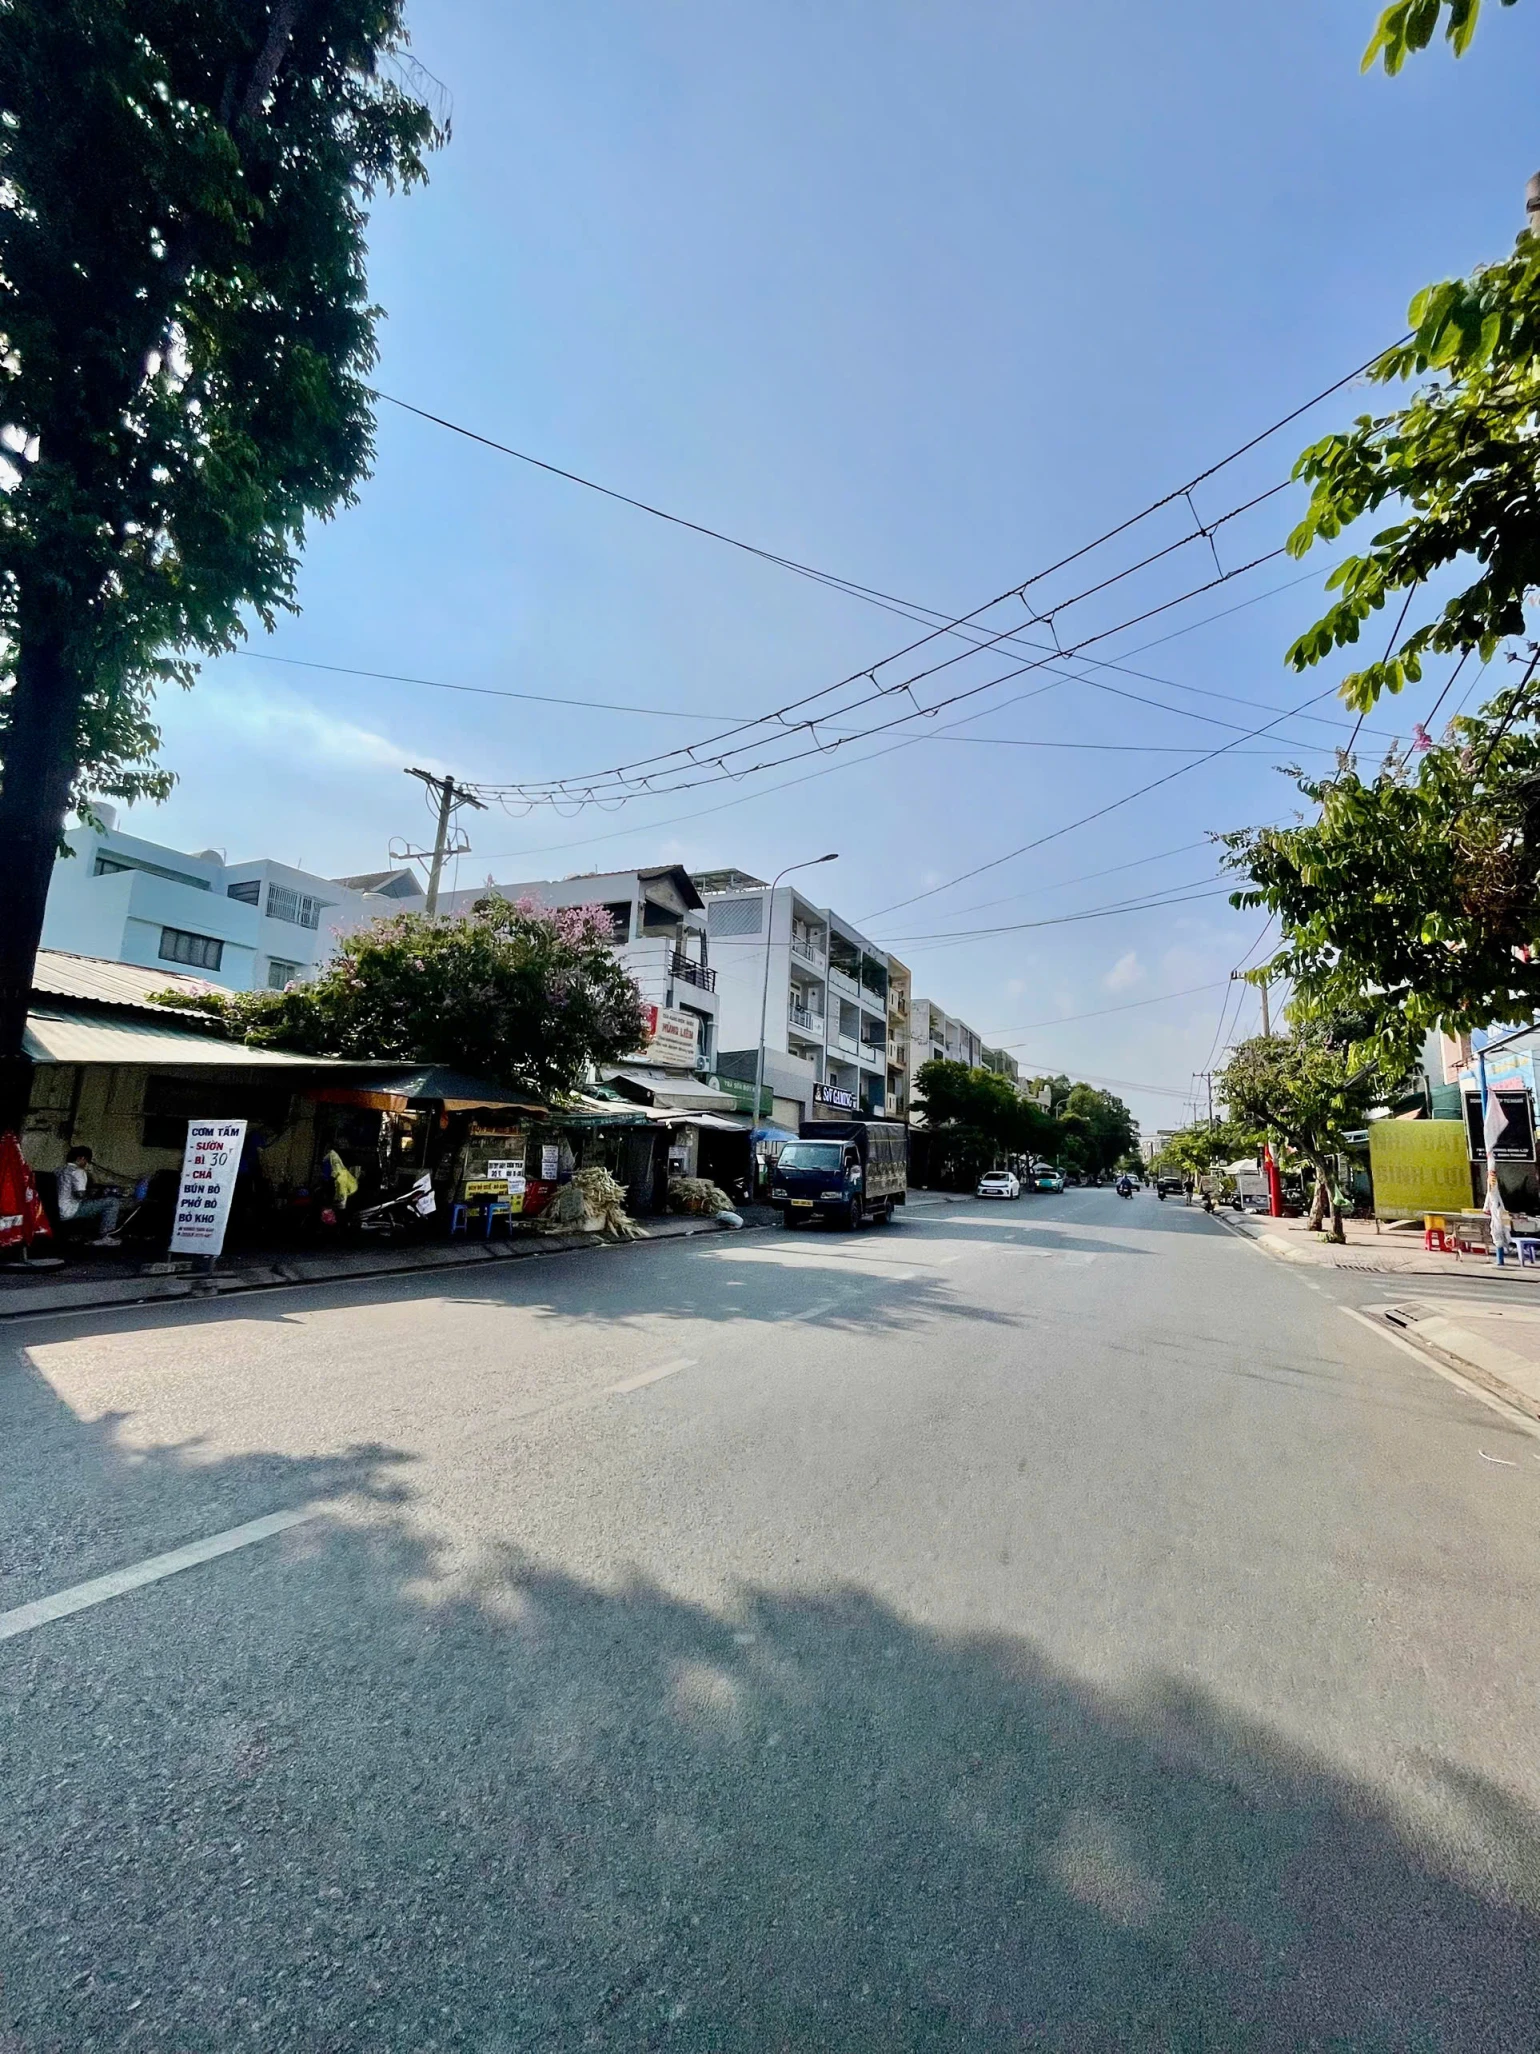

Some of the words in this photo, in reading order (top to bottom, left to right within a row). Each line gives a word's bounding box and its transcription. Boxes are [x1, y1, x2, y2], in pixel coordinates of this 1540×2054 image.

[191, 1126, 215, 1137] CƠM
[217, 1124, 241, 1137] TẤM
[196, 1140, 225, 1151] SƯỜN
[194, 1154, 205, 1165] BÌ
[209, 1152, 228, 1167] 30
[192, 1167, 212, 1179] CHẢ
[183, 1183, 205, 1194] BÚN
[207, 1183, 221, 1195] BÒ
[180, 1196, 203, 1208] PHỞ
[204, 1198, 218, 1209] BÒ
[178, 1211, 192, 1223] BÒ
[194, 1214, 215, 1224] KHO
